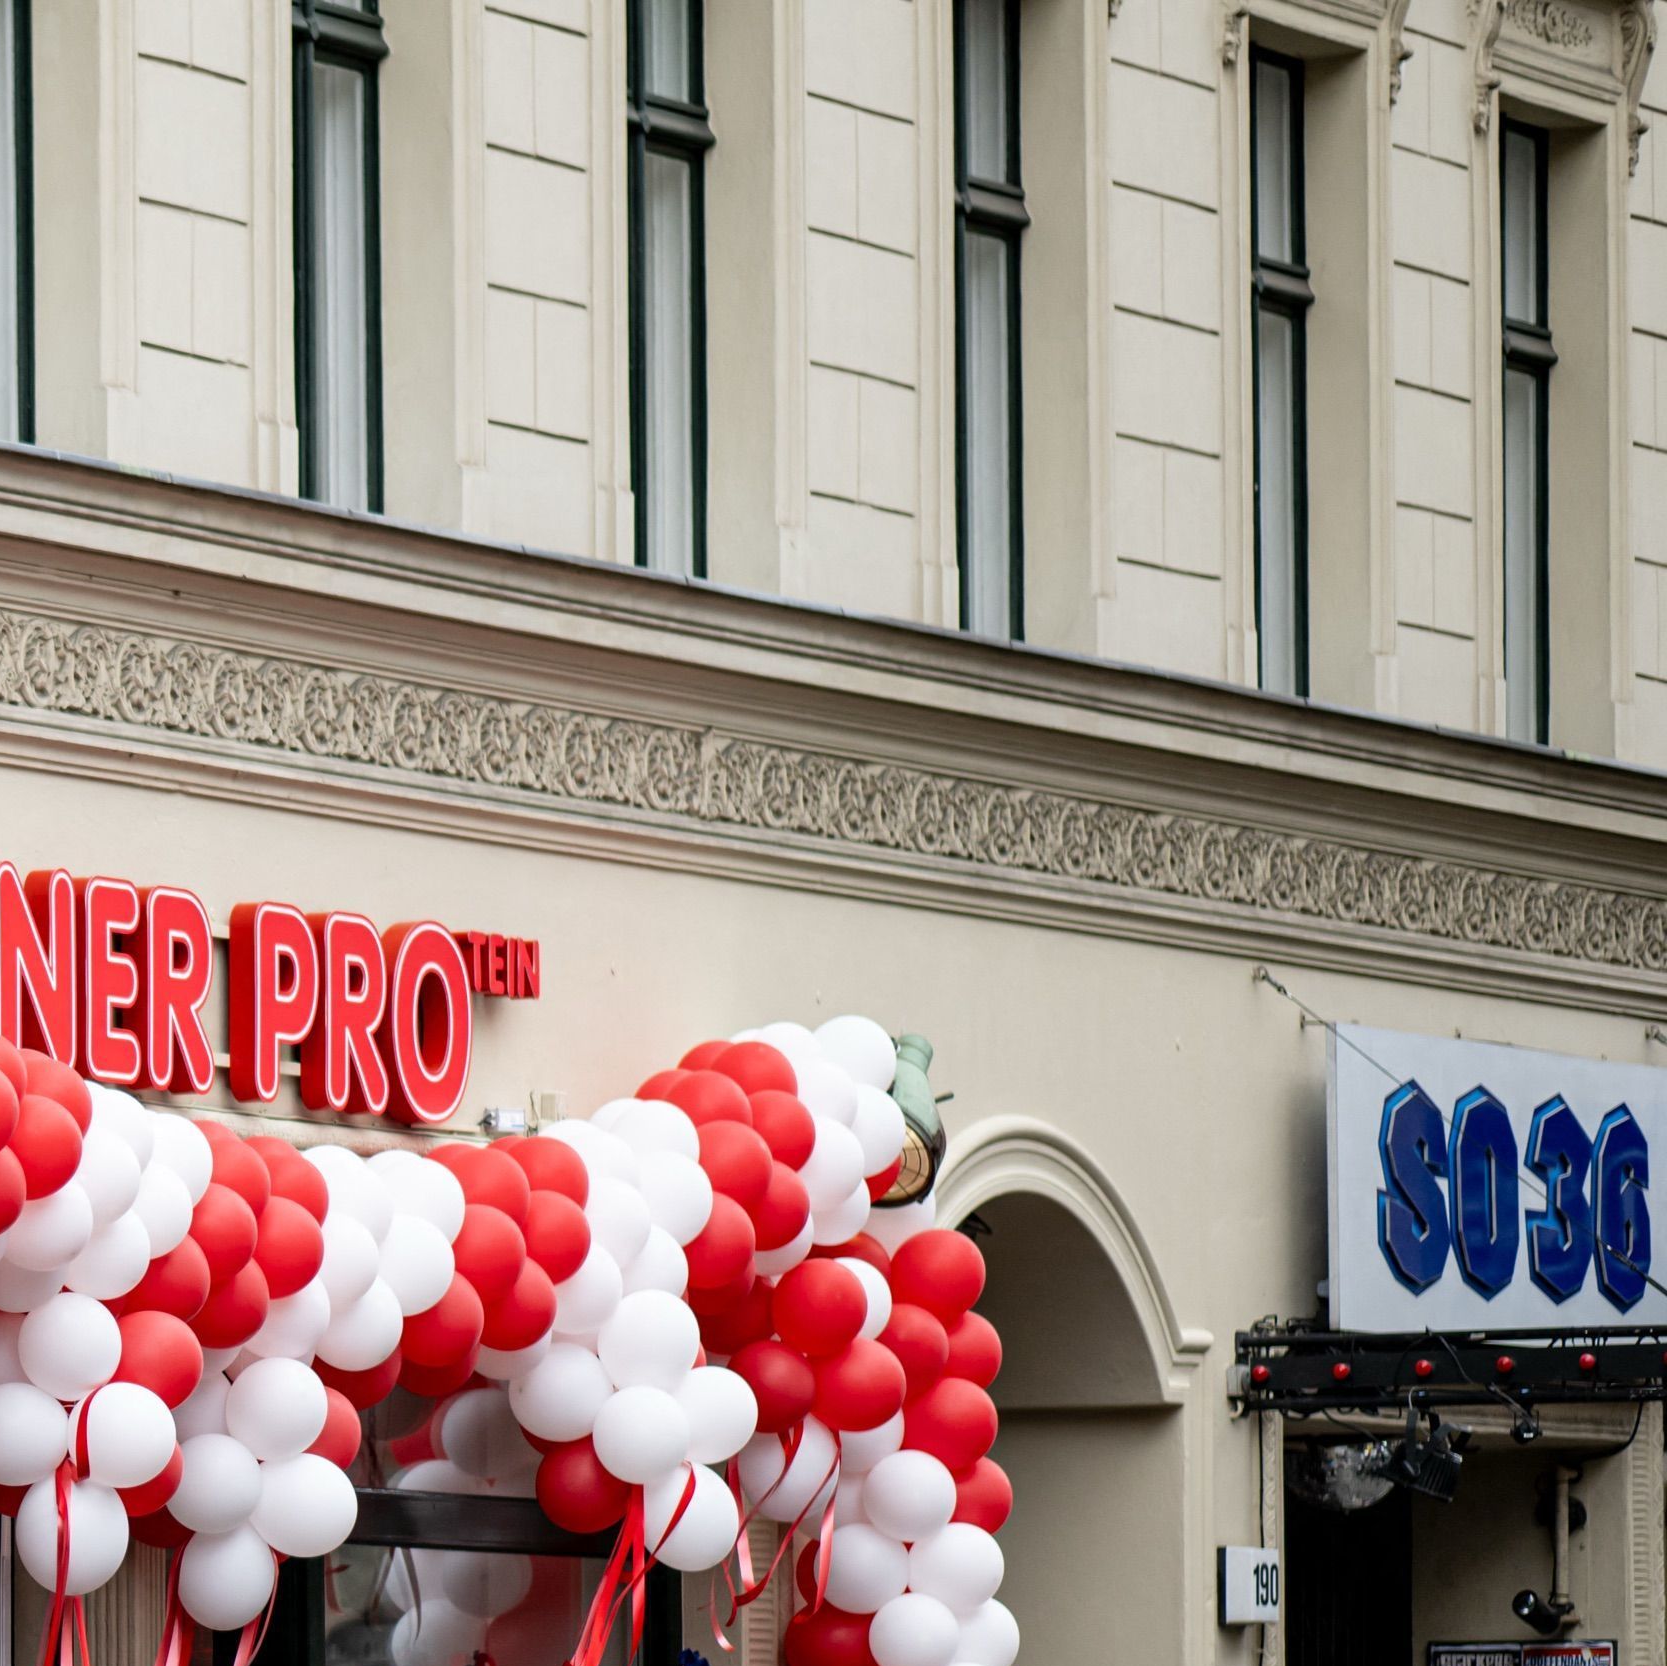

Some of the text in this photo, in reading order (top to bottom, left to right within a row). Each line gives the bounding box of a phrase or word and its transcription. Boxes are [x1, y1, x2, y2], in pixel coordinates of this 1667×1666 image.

[230, 902, 472, 1124] PRO
[462, 930, 540, 999] TEIN
[1377, 1078, 1652, 1315] SO36
[1253, 1563, 1279, 1607] 190
